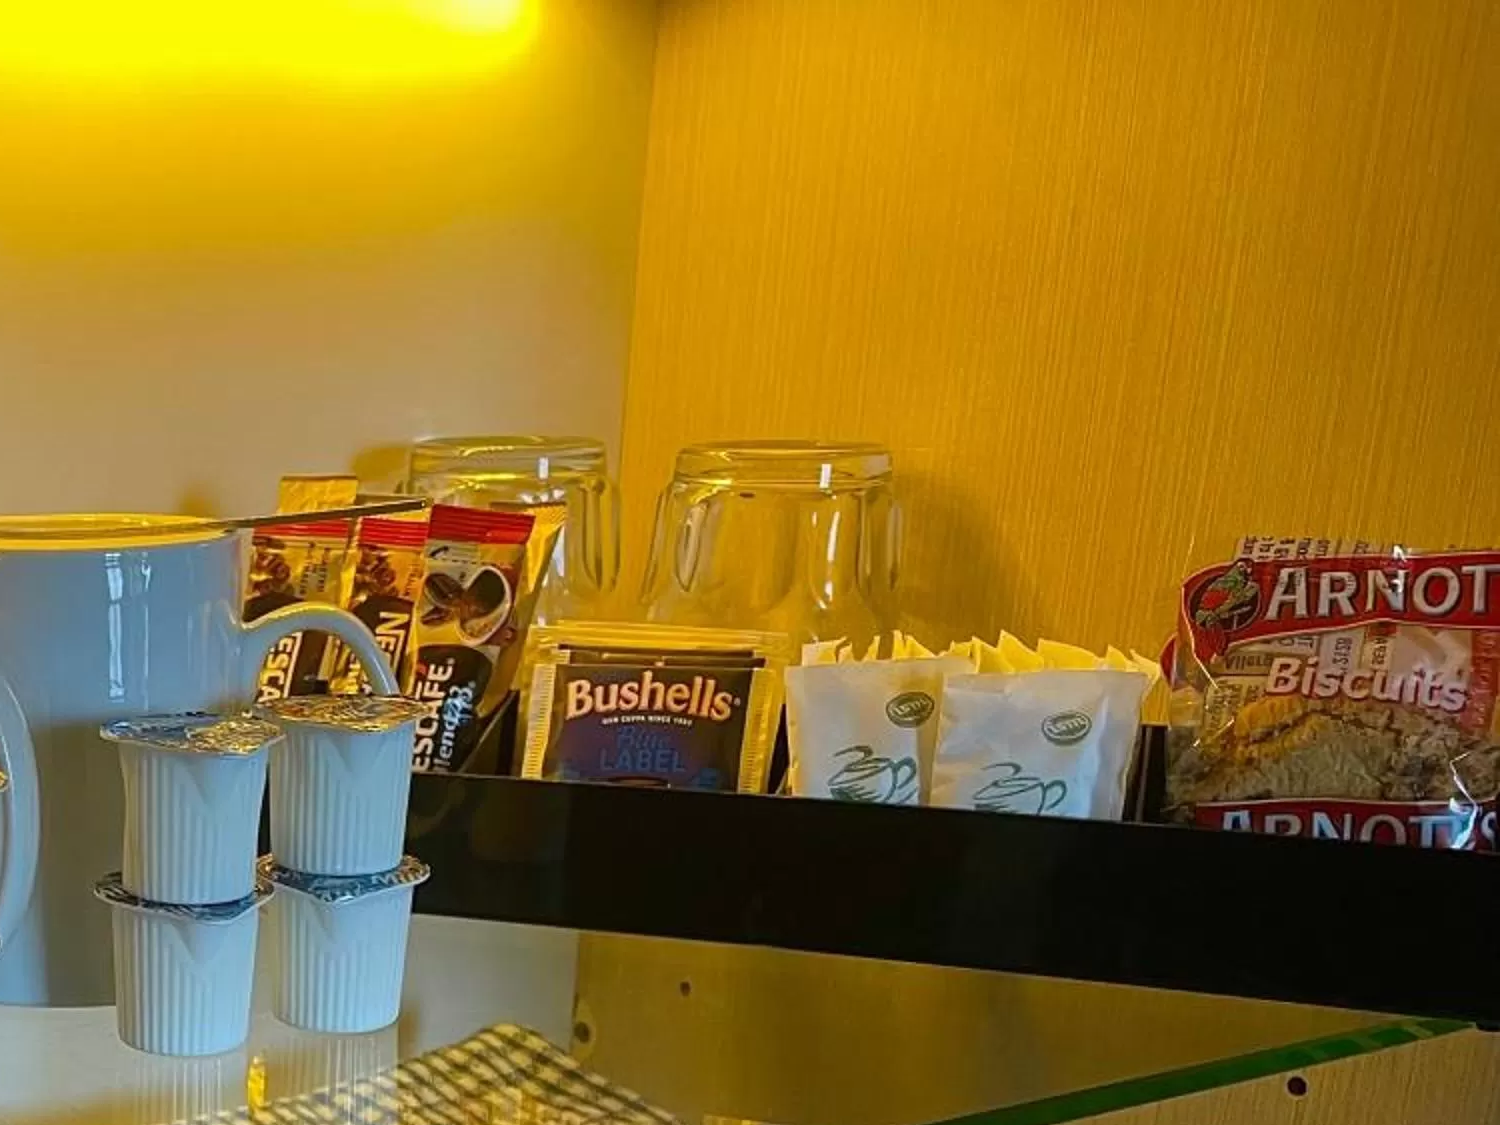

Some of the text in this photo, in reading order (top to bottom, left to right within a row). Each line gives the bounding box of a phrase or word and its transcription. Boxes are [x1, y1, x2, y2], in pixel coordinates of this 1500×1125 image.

[1264, 564, 1500, 621] ARNOT
[565, 669, 734, 721] Bushells
[1265, 656, 1468, 713] Biscuits
[411, 661, 454, 774] ESCAFÉ
[601, 747, 686, 773] LABEL
